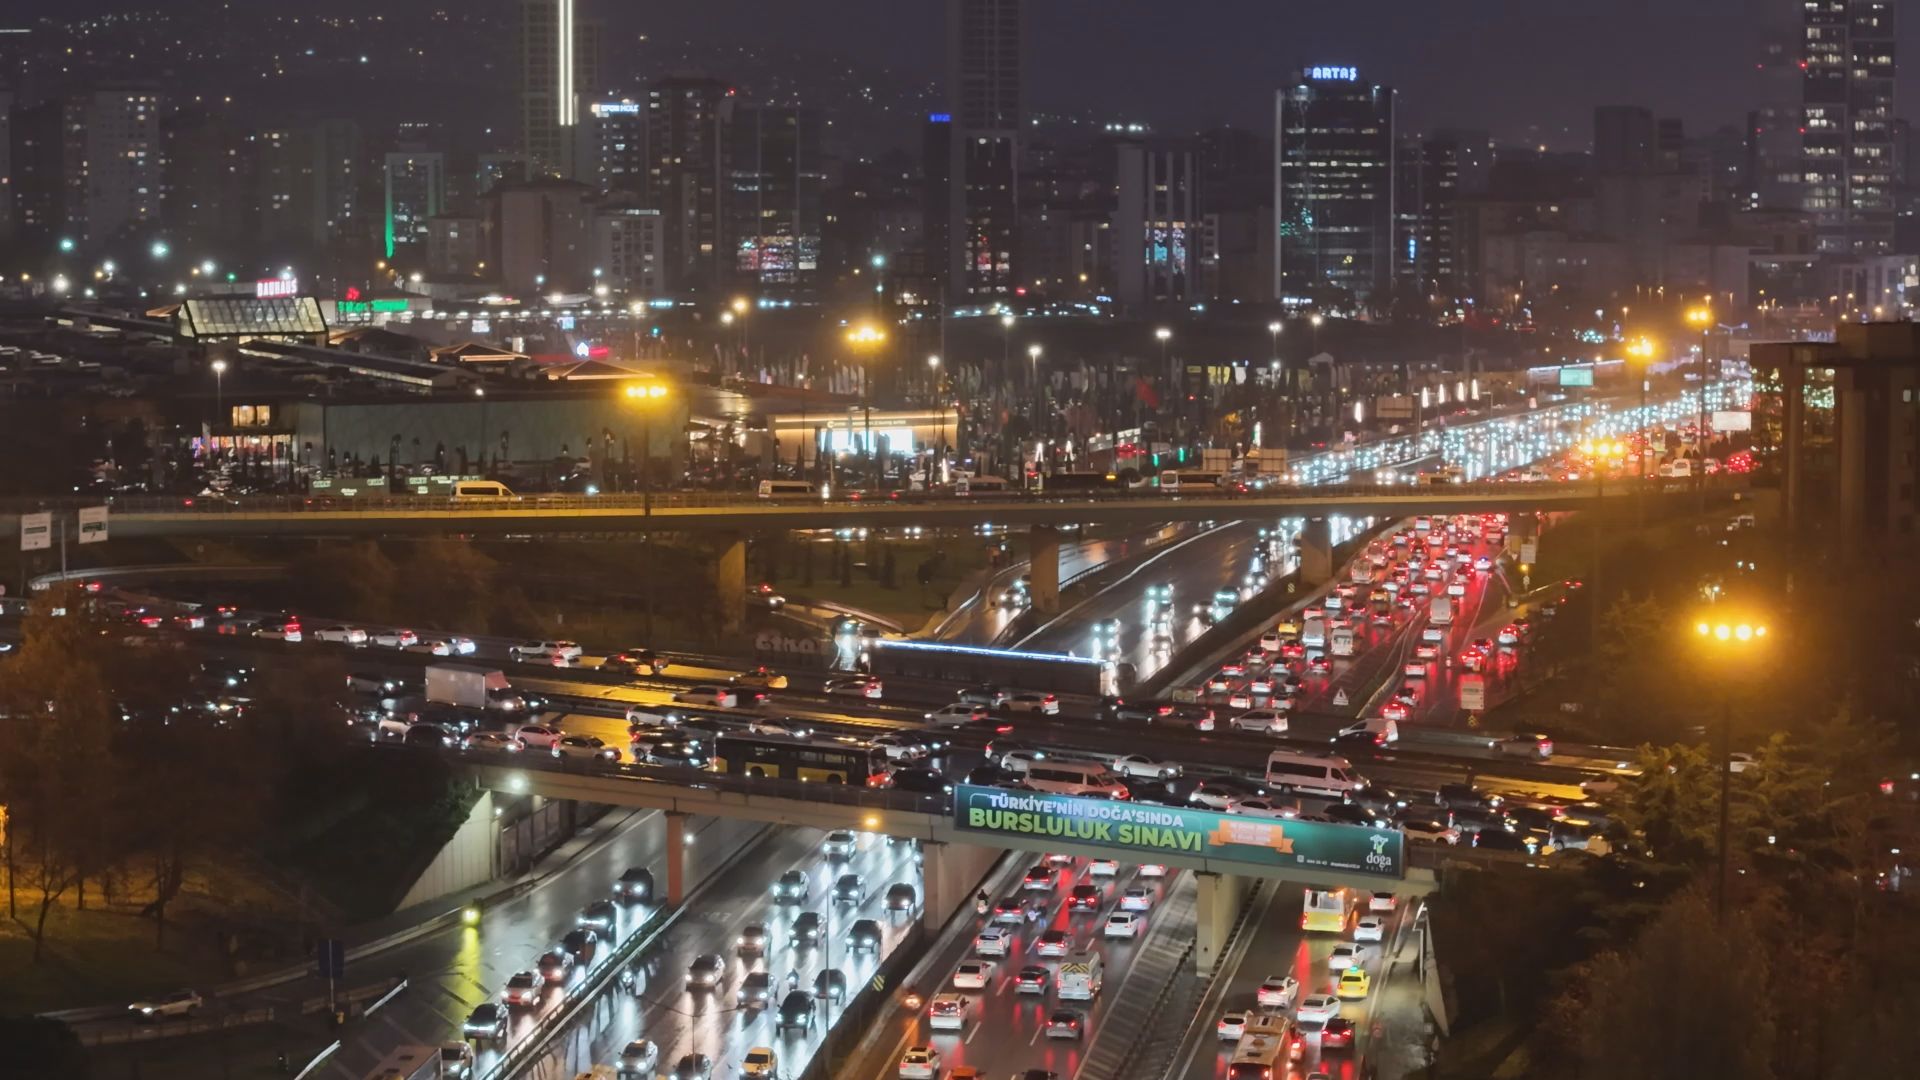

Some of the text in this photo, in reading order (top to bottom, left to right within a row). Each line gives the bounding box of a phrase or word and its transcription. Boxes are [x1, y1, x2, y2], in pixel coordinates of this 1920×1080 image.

[969, 807, 1112, 842] BURSLULUK
[1118, 824, 1202, 852] SINAVI
[988, 792, 1185, 828] TÜRKİYE'NİN DOĞA'SINDA
